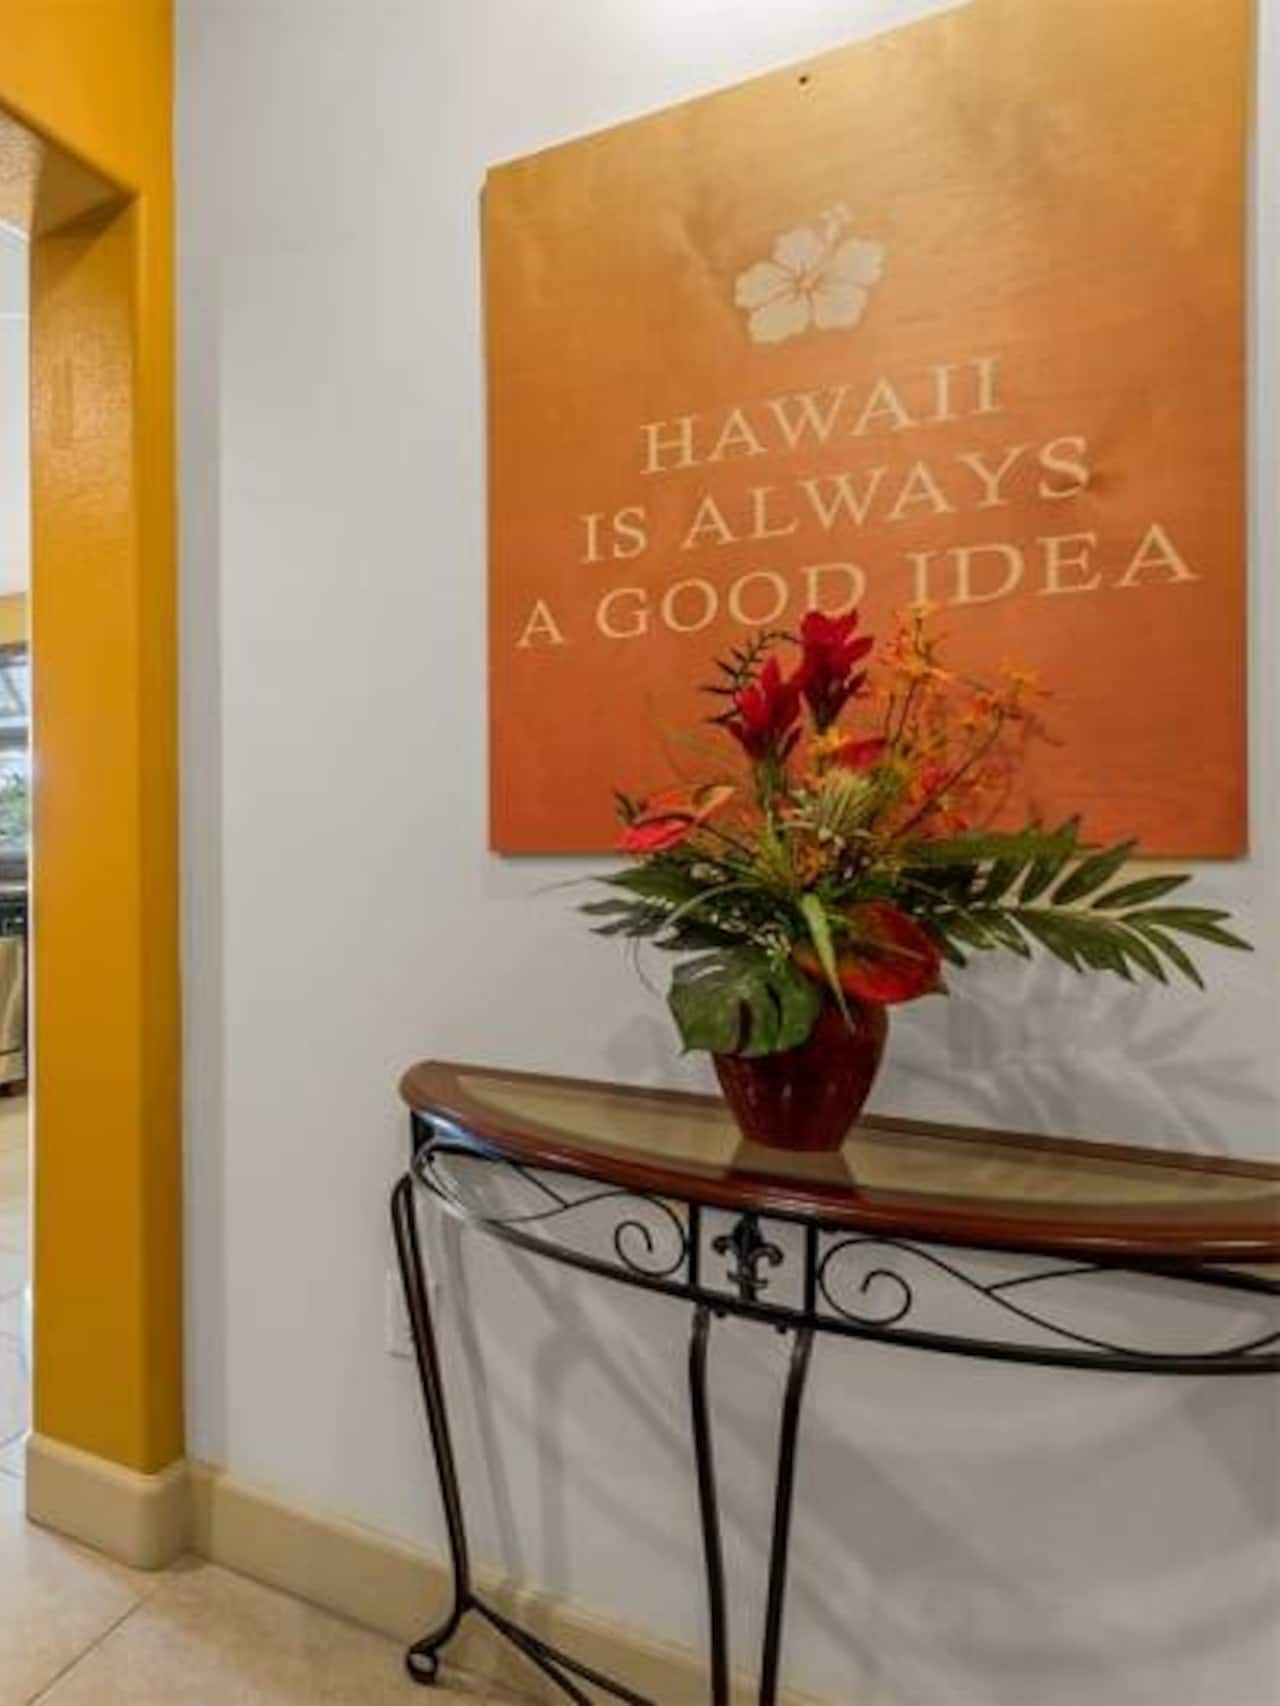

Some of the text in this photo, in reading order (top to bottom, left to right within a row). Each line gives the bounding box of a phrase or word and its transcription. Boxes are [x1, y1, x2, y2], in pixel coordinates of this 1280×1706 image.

[639, 357, 1005, 476] HAWAII
[578, 435, 1091, 564] IS ALWAYS
[516, 522, 1201, 649] A GOOD IDEA
